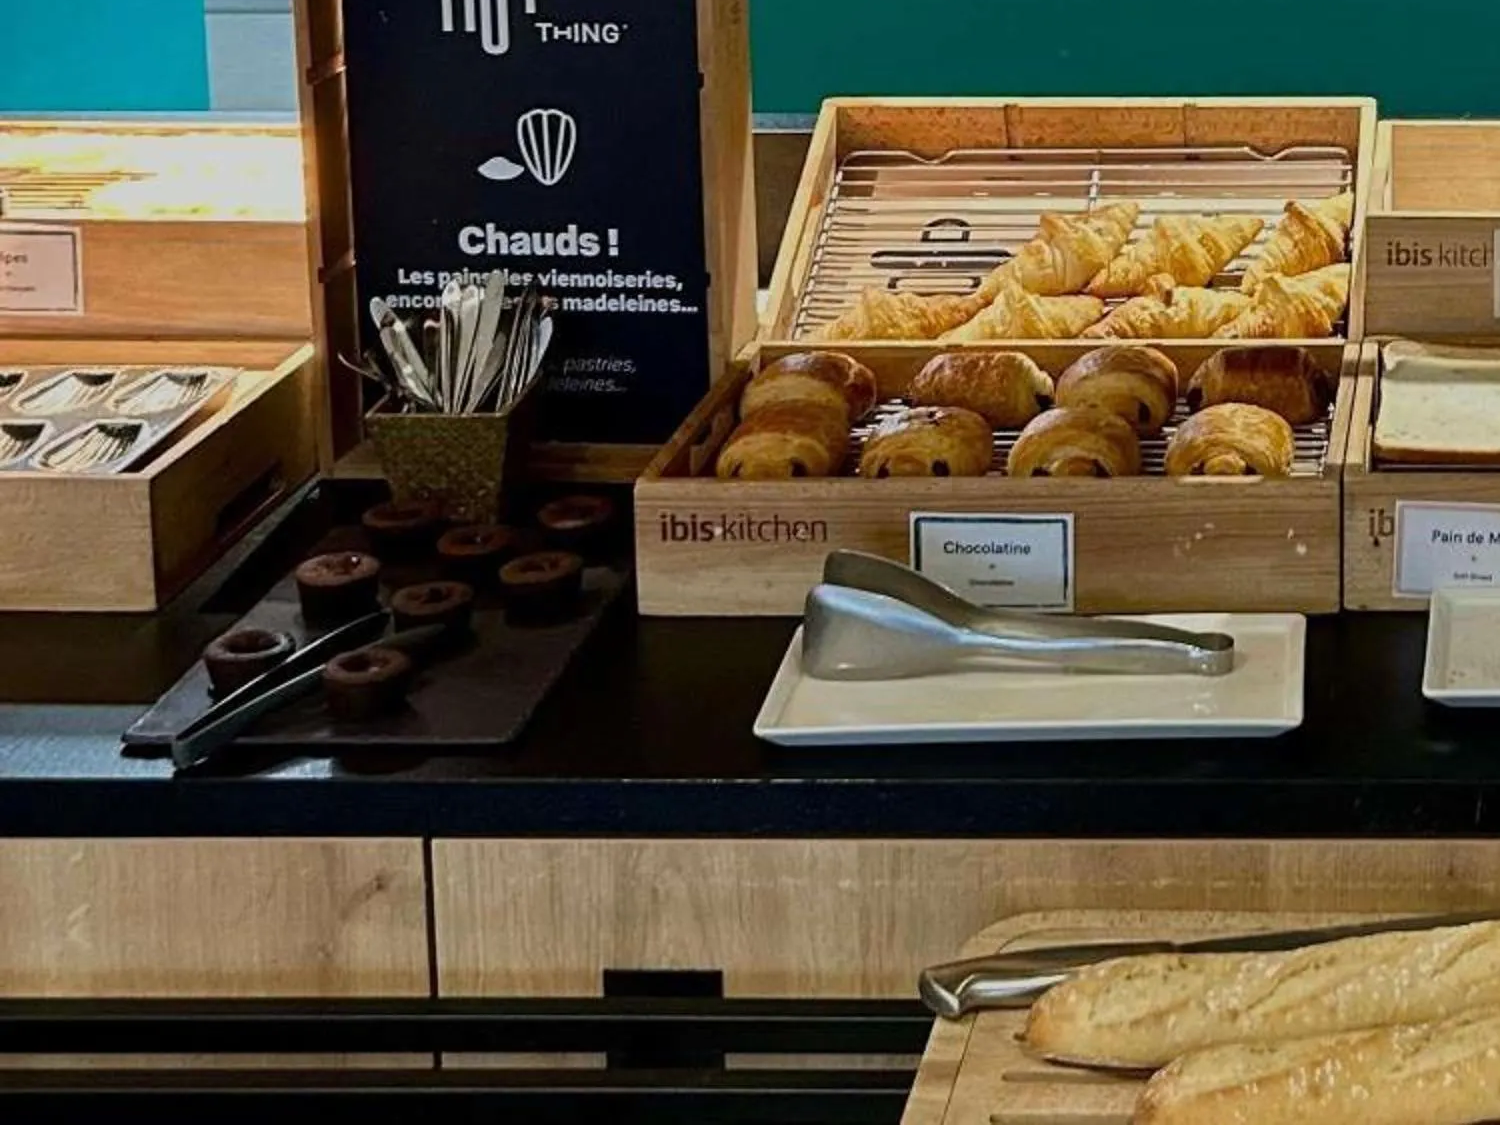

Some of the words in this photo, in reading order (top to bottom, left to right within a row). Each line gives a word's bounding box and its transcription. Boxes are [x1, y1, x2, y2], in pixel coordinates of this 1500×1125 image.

[534, 22, 621, 44] THING
[458, 222, 601, 257] Chauds
[1385, 241, 1433, 267] ibis
[399, 268, 435, 286] Les
[538, 269, 684, 292] viennoiseries,
[386, 294, 442, 309] encor
[562, 293, 699, 313] madeleines...
[659, 512, 715, 543] ibis
[720, 512, 829, 543] kitchen
[1431, 528, 1463, 544] Pain
[1466, 530, 1485, 545] de
[943, 540, 1032, 556] Chocolatine
